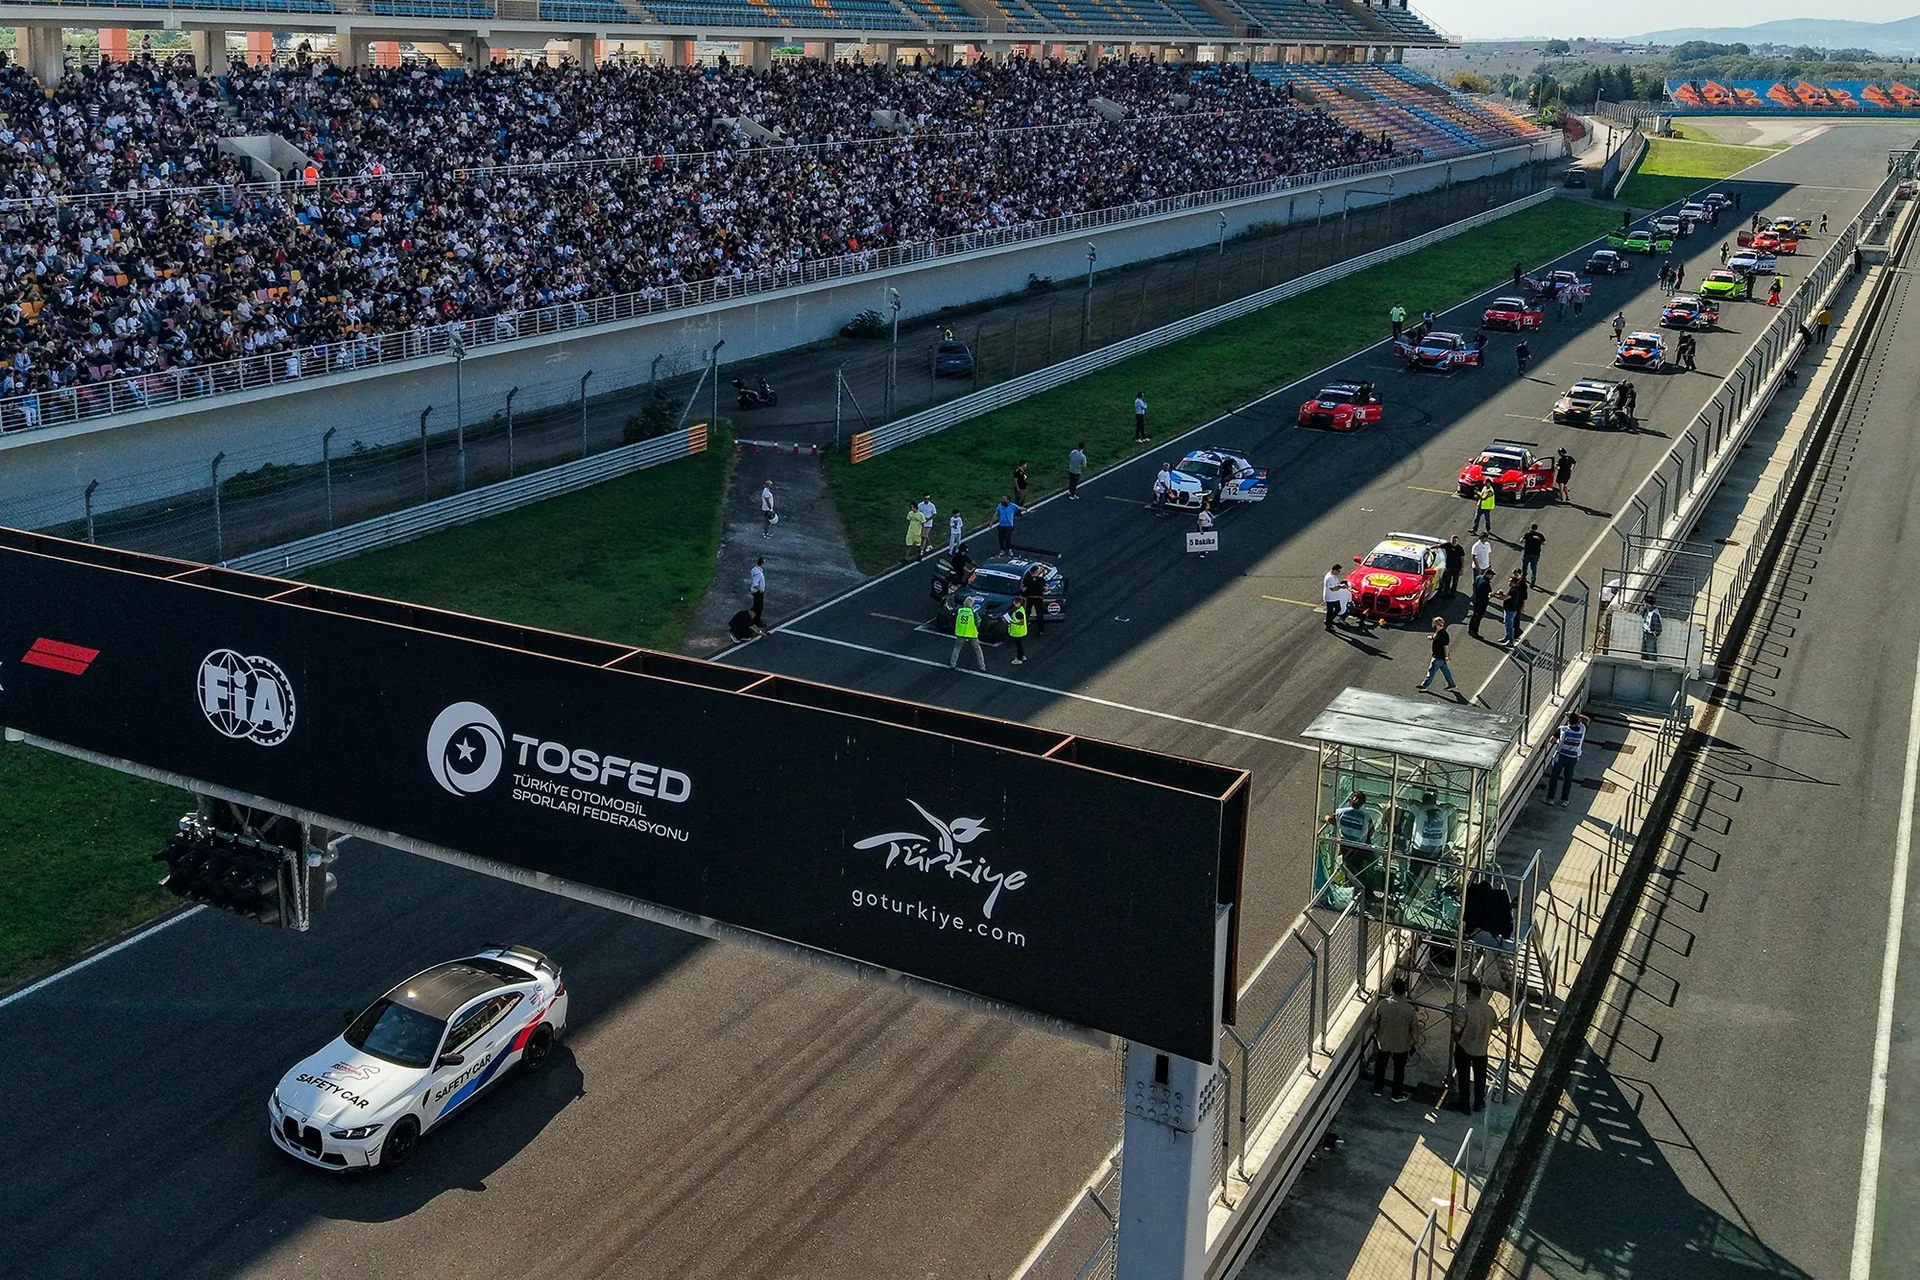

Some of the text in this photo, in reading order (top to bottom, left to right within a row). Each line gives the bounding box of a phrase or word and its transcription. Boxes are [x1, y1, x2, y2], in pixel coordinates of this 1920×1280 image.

[1226, 487, 1239, 496] 12
[1195, 537, 1216, 546] Dakika
[512, 733, 692, 803] TOSFED
[512, 773, 647, 817] TÜRKİYE OTOMOBİL
[512, 788, 690, 843] SPORLARI FEDERASYONU
[853, 831, 1028, 919] Türkiye
[851, 889, 1026, 948] goturkiye.com
[295, 1073, 370, 1109] SAFETY CAR
[434, 1053, 492, 1102] SAFETY CAR
